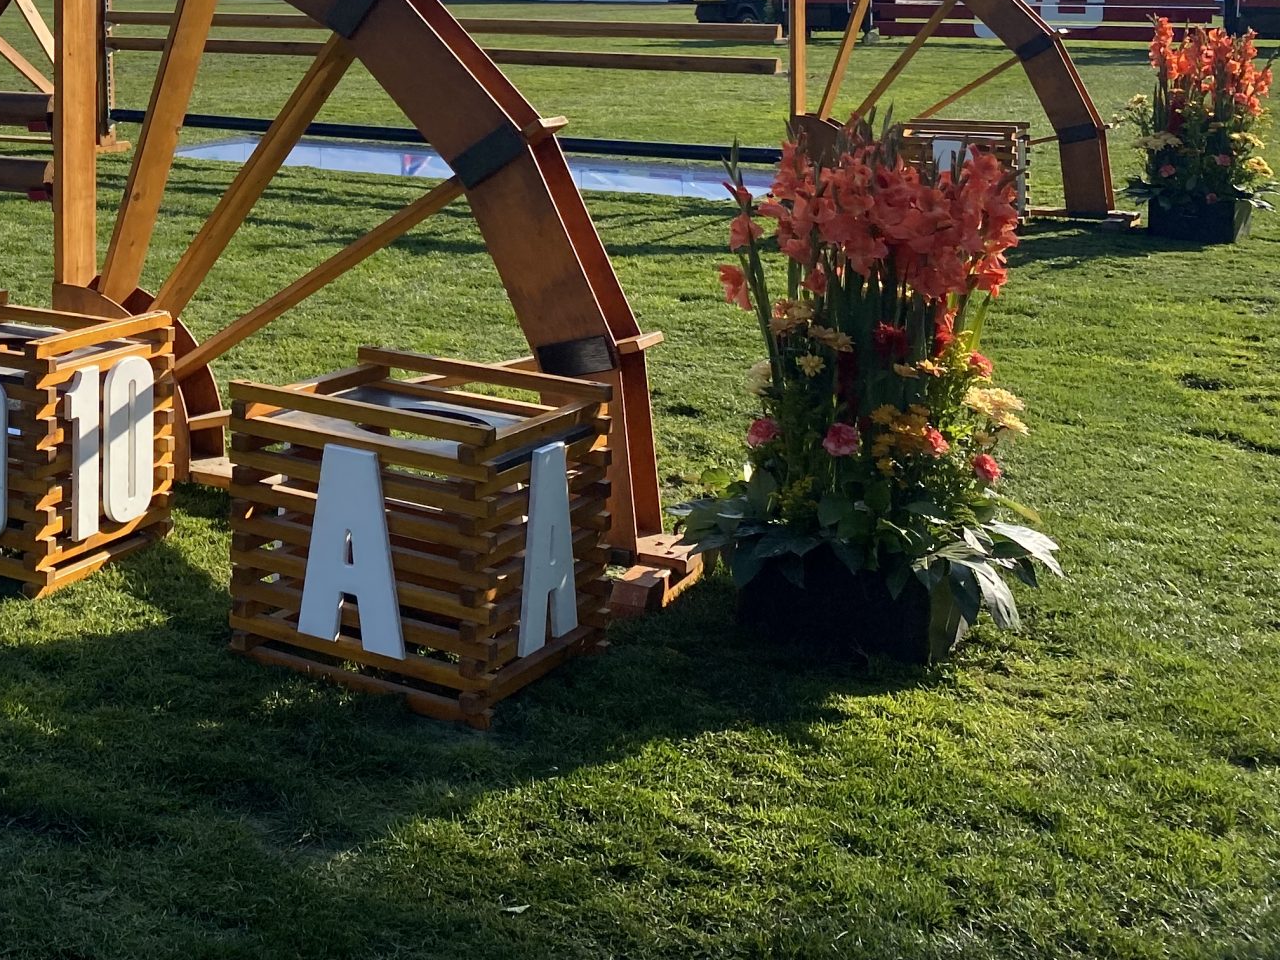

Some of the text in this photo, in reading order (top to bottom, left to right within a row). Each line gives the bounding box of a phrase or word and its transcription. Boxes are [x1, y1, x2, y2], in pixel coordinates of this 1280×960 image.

[65, 355, 155, 542] 10
[297, 442, 407, 661] A
[518, 440, 579, 659] A
